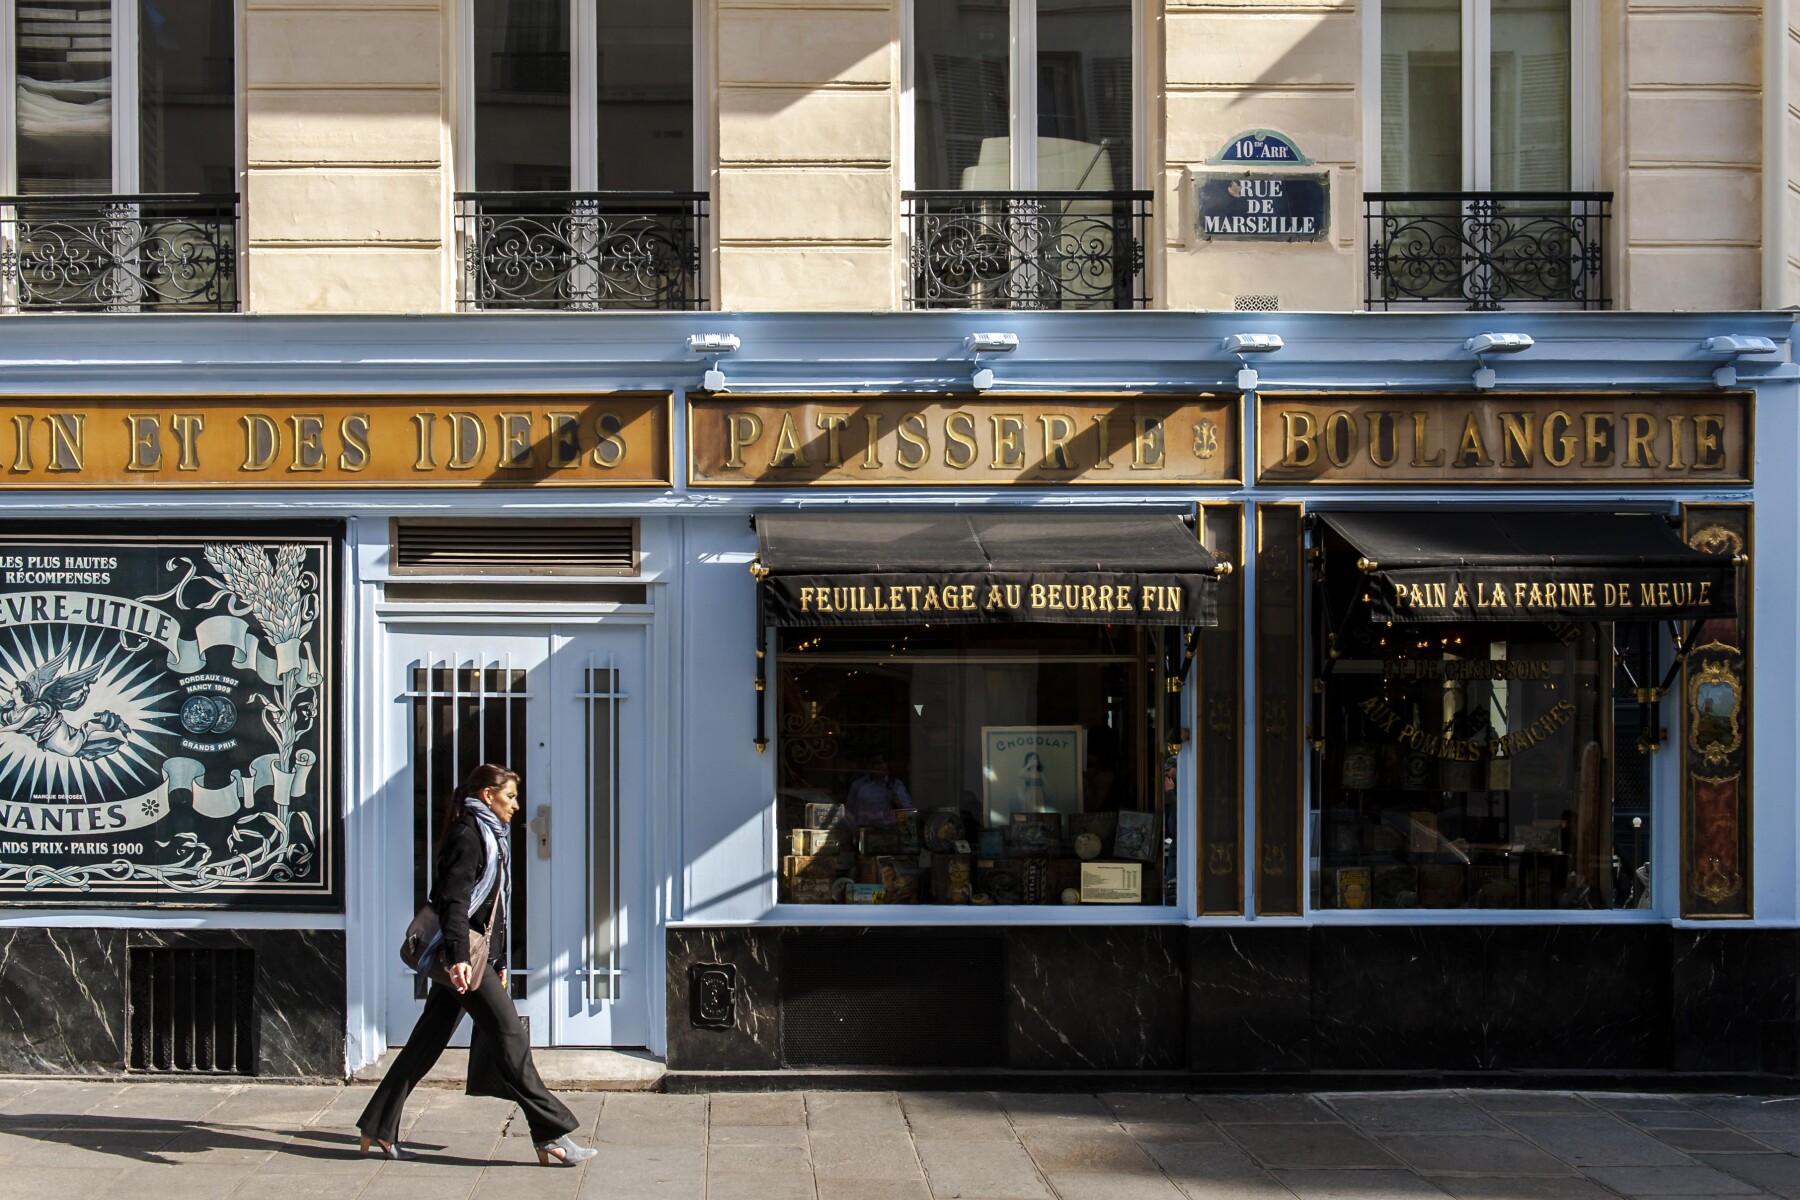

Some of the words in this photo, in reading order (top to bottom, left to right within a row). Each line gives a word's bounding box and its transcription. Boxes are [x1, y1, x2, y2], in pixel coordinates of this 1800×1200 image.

[1240, 180, 1282, 197] RUE
[1246, 199, 1273, 214] DE
[1204, 216, 1315, 234] MARSEILLE
[0, 413, 87, 472] IN
[127, 412, 205, 472] ET
[242, 411, 371, 472] DES
[414, 410, 628, 471] IDEES
[725, 410, 1167, 471] PATISSERIE
[1281, 409, 1727, 470] BOULANGERIE
[0, 556, 24, 568] LES
[27, 556, 60, 569] PLUS
[65, 556, 118, 570] HAUTES
[5, 567, 111, 585] RÉCOMPENSES
[799, 584, 978, 613] FEUILLETAGE
[987, 584, 1021, 610] AU
[1030, 583, 1132, 612] BEURRE
[1141, 585, 1183, 612] FIN
[1395, 582, 1447, 608] PAIN
[1452, 582, 1470, 607] A
[1477, 582, 1508, 607] LA
[1514, 582, 1596, 608] FARINE
[1604, 582, 1631, 607] DE
[1640, 581, 1713, 607] MEULE
[1414, 659, 1440, 680] DE
[1445, 659, 1552, 680] CHAUSSONS
[179, 674, 220, 687] BORDEAUX
[222, 676, 239, 687] 1907
[186, 683, 212, 693] NANCY
[214, 684, 231, 694] 1909
[1358, 695, 1401, 733] AUX
[1396, 724, 1481, 762] POMMES
[182, 740, 215, 751] GRANDS
[218, 739, 237, 750] PRIX
[996, 736, 1069, 752] CHOCOLAT
[0, 841, 29, 854] NDS
[32, 842, 63, 854] PRIX
[70, 842, 109, 855] PARIS
[112, 842, 143, 855] 1900
